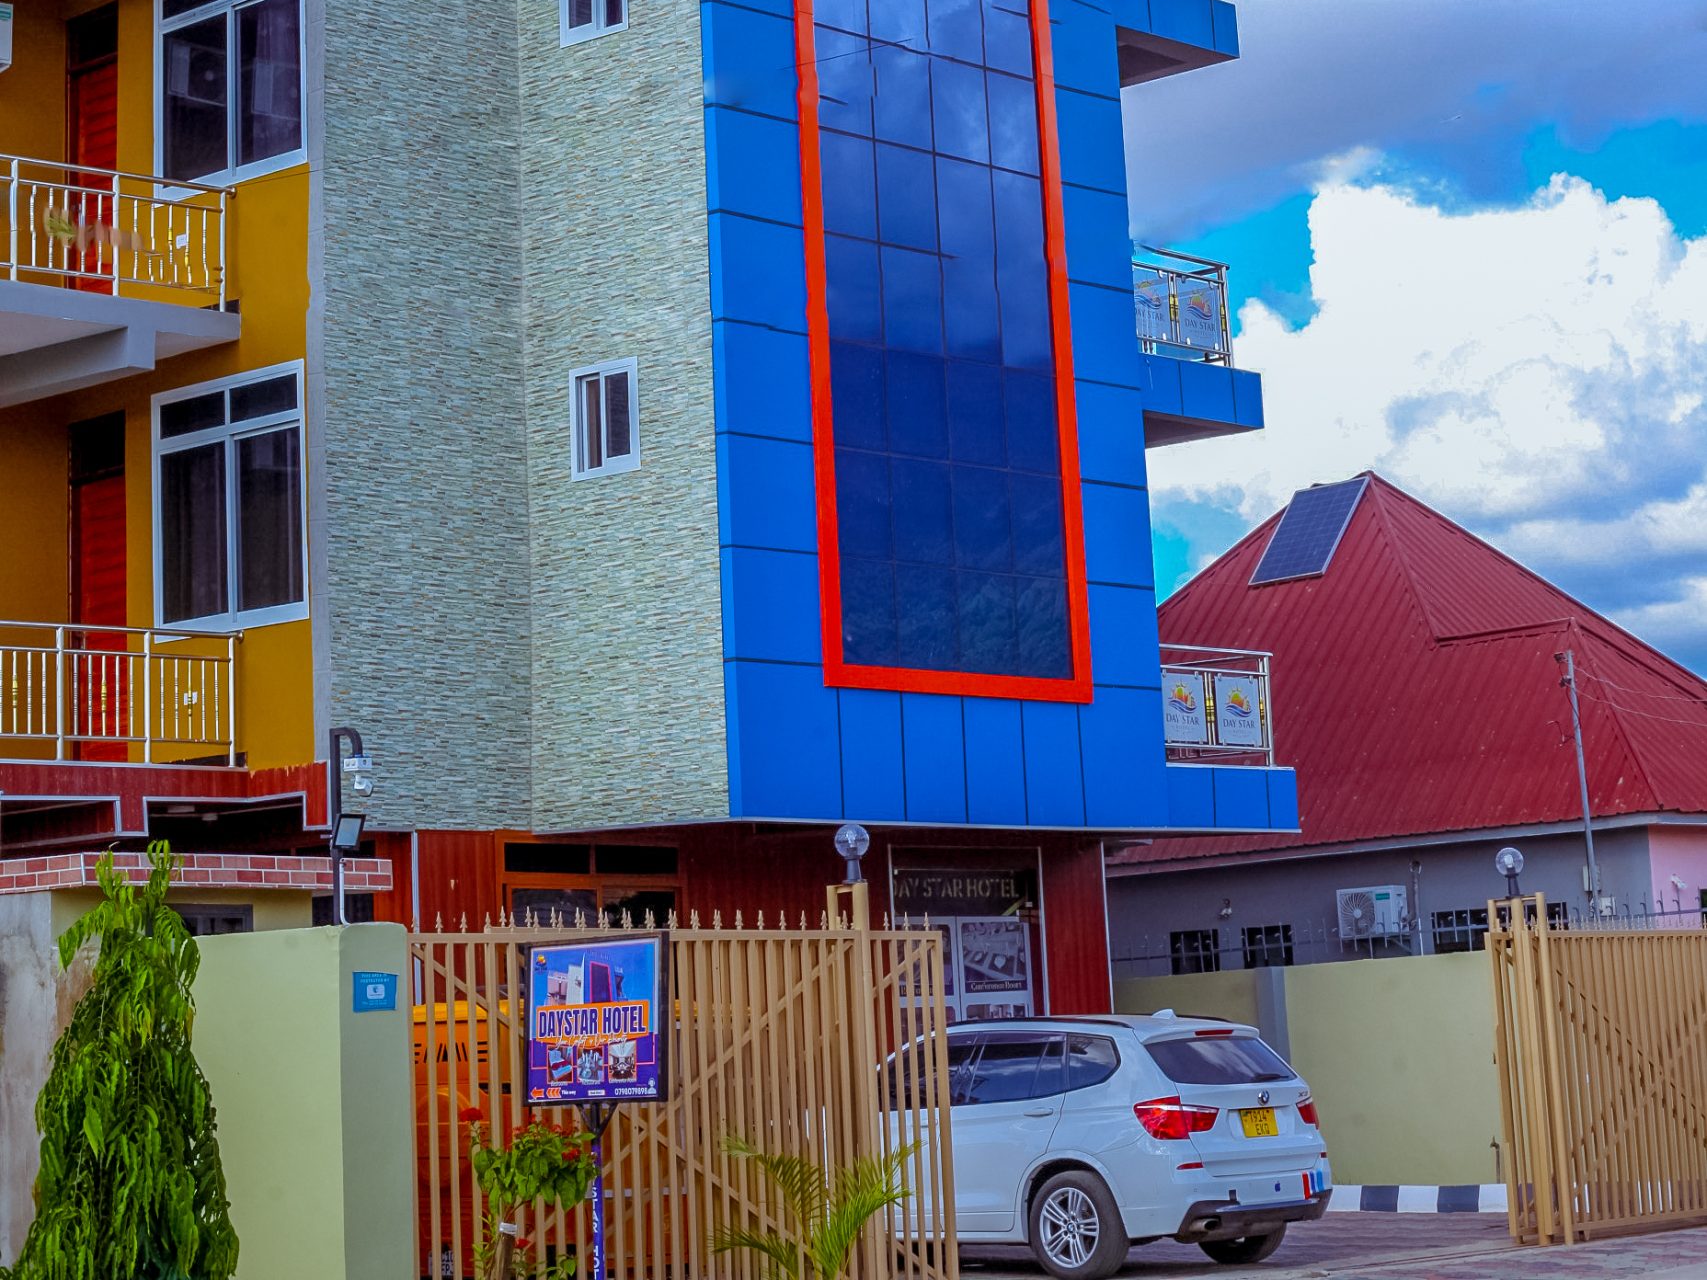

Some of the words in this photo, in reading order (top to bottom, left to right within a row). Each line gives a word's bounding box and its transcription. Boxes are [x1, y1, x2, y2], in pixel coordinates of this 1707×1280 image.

[1199, 322, 1216, 331] STAR
[1166, 712, 1180, 723] DAY
[1182, 715, 1199, 726] STAR
[1223, 719, 1237, 729] DAY
[1238, 720, 1255, 729] STAR
[923, 878, 963, 898] STAR
[966, 878, 1020, 898] HOTEL
[538, 1008, 598, 1038] DAYSTAR
[602, 1004, 647, 1035] HOTEL
